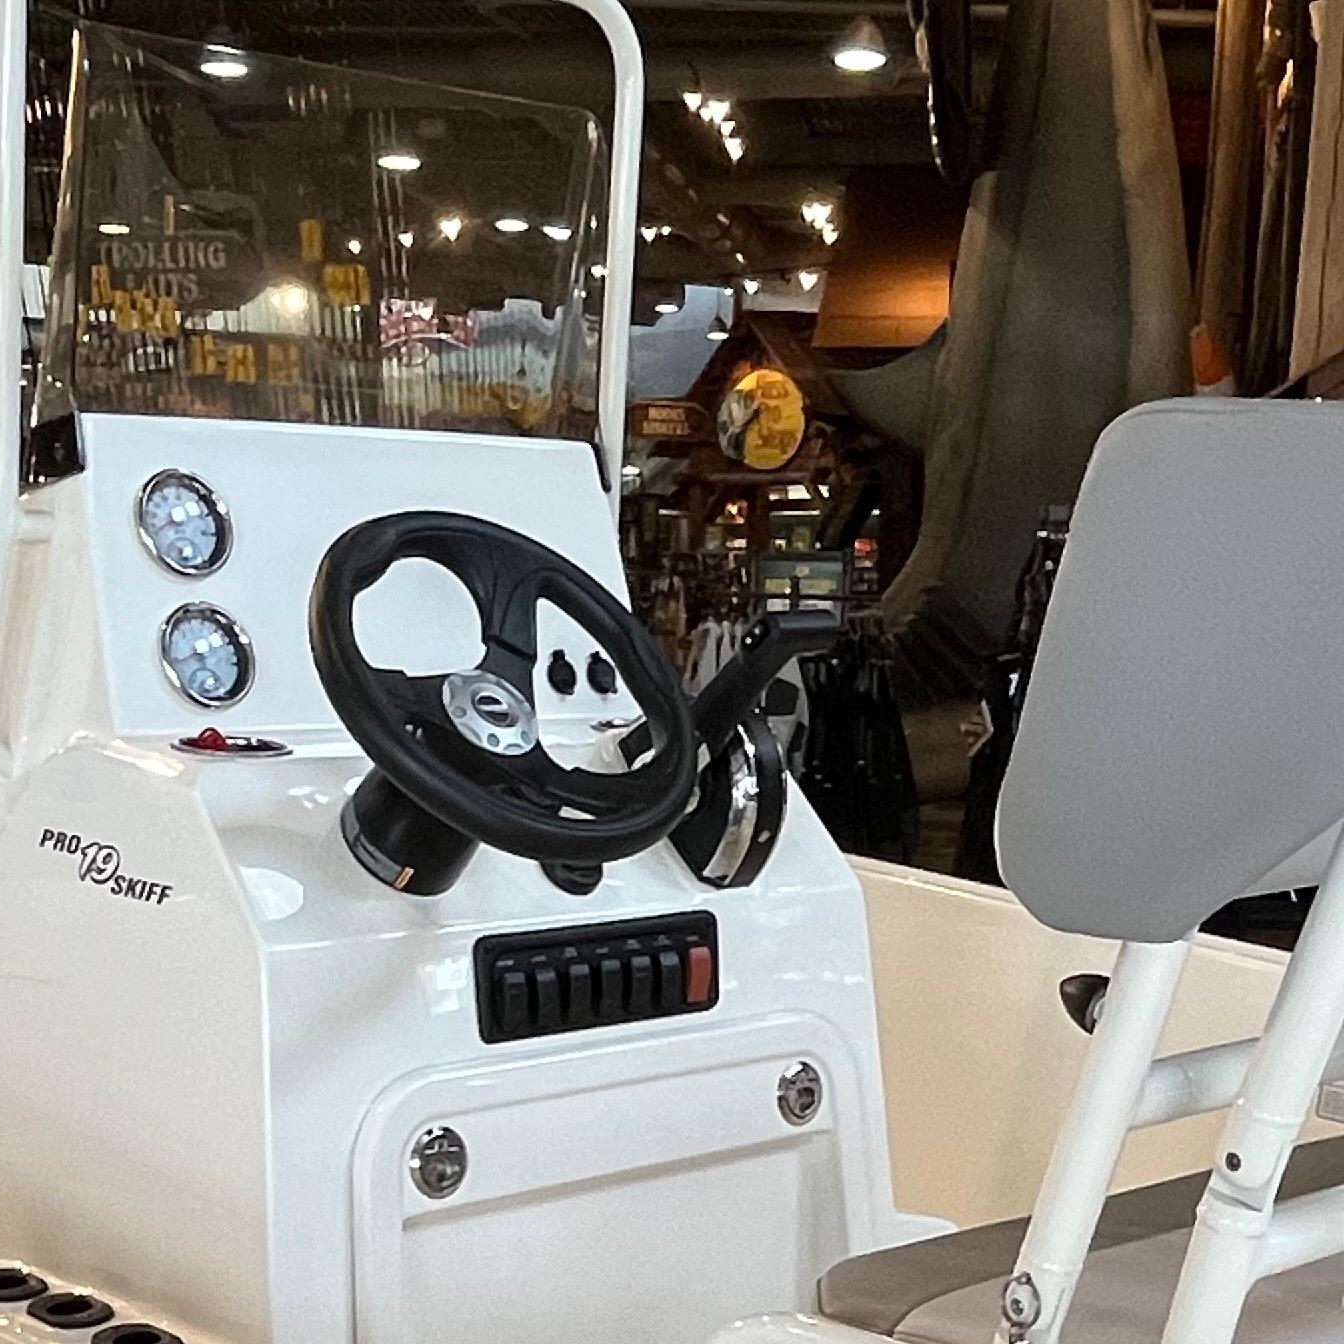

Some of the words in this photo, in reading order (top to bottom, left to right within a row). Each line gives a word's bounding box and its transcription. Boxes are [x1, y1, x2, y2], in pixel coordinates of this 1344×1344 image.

[39, 828, 81, 854] PRO
[79, 842, 120, 884] 19
[110, 874, 174, 905] SKIFF
